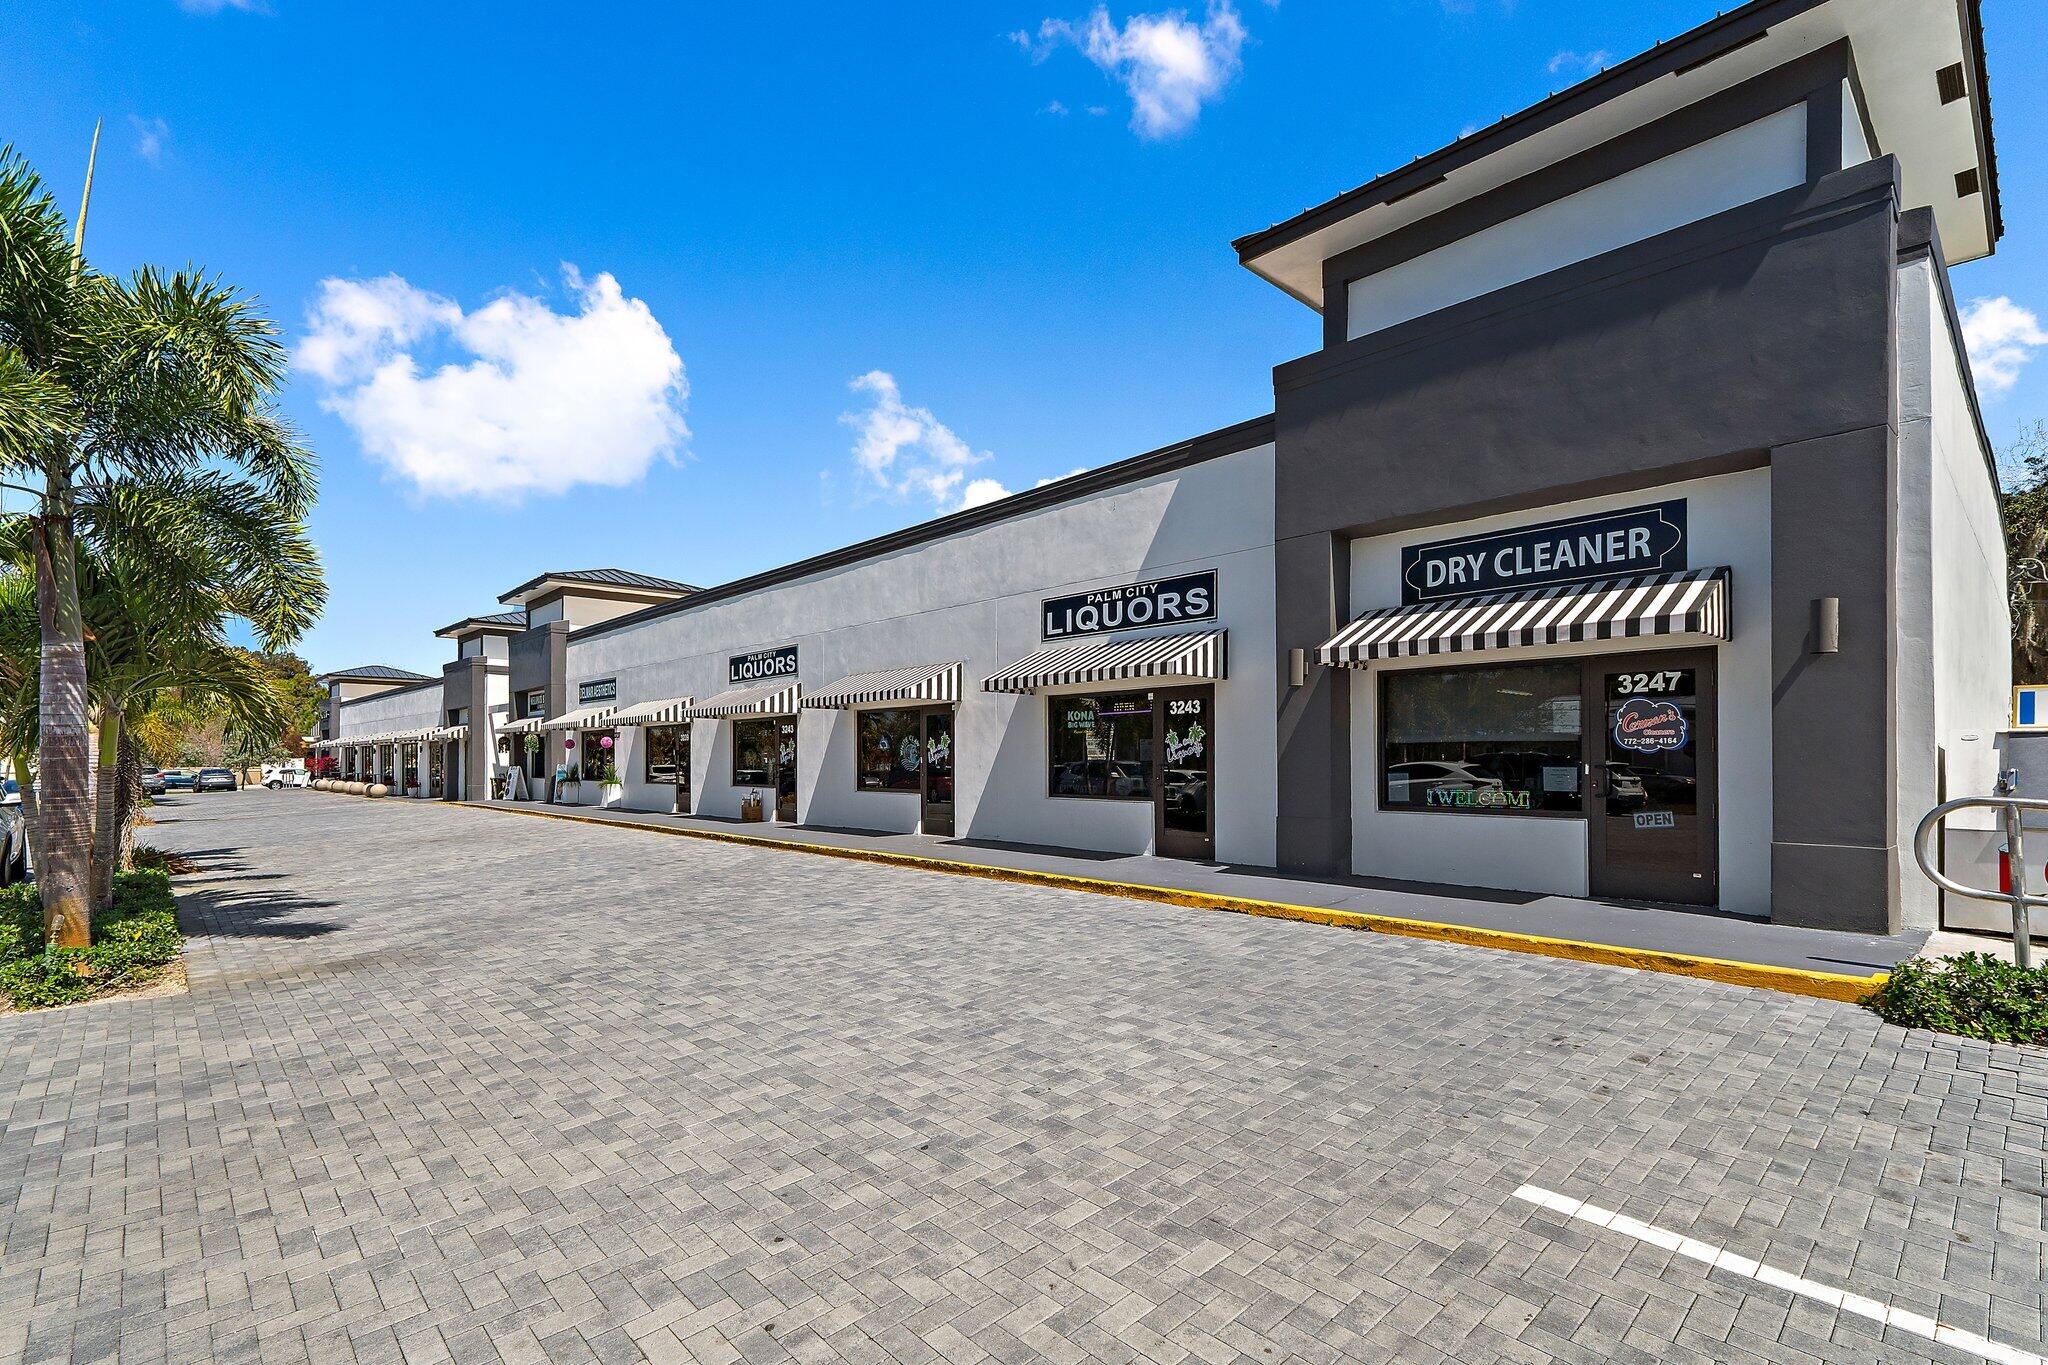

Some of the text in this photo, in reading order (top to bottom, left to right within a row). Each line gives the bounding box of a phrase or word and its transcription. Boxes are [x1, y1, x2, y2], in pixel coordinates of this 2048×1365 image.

[1426, 527, 1651, 588] DRY CLEANER
[1087, 584, 1159, 604] PALM CITY
[1047, 588, 1209, 635] LIQUORS
[747, 651, 777, 662] PALM CITY
[731, 654, 796, 681] LIQUORS
[1618, 671, 1682, 694] 3247
[1067, 710, 1095, 722] KONA
[1170, 700, 1201, 715] 3243
[781, 724, 794, 734] 3243
[1636, 813, 1673, 827] OPEN
